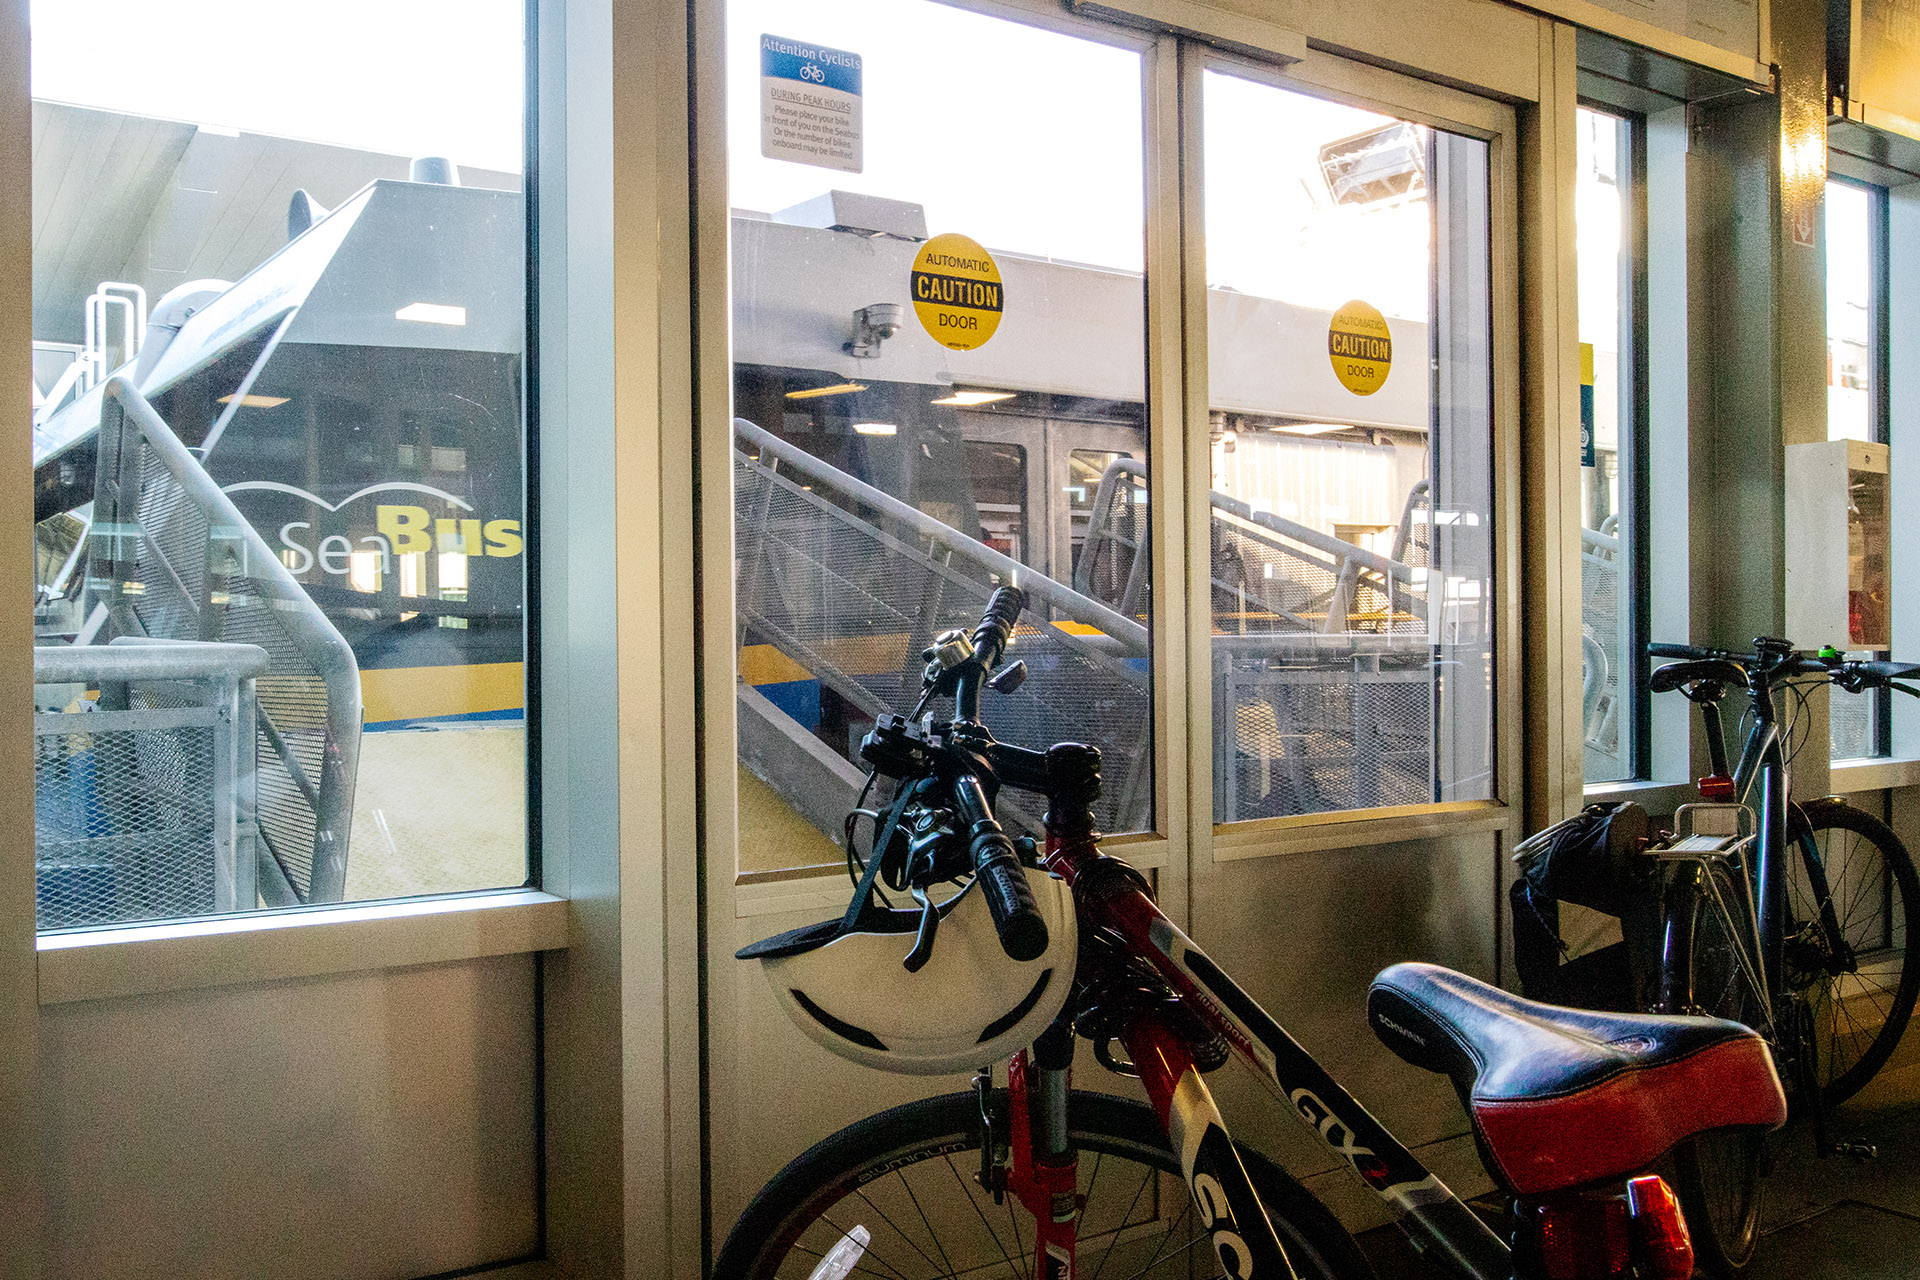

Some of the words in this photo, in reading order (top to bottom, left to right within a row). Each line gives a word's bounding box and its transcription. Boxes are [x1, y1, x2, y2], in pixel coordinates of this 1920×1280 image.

[762, 38, 816, 61] Attention
[818, 50, 862, 69] Cyclists
[770, 87, 802, 103] DURING
[803, 93, 824, 106] PEAK
[824, 98, 852, 112] HOURS
[771, 115, 789, 127] front
[789, 119, 798, 129] of
[798, 122, 811, 134] you
[812, 123, 821, 132] on
[822, 124, 834, 134] the
[834, 126, 860, 139] Seabus
[774, 104, 798, 117] Please
[798, 108, 818, 122] place
[818, 114, 834, 125] your
[835, 114, 850, 127] bike
[772, 138, 803, 151] onboard
[803, 144, 818, 155] may
[818, 145, 828, 155] be
[828, 147, 853, 160] limited
[773, 126, 783, 137] Or
[783, 129, 796, 139] the
[796, 132, 824, 144] number
[824, 134, 832, 145] of
[832, 136, 852, 149] bikes
[926, 253, 990, 273] AUTOMATIC
[917, 275, 998, 308] CAUTION
[939, 313, 978, 330] DOOR
[1338, 315, 1383, 330] AUTOMATIC
[1332, 333, 1389, 360] CAUTION
[1347, 364, 1375, 379] DOOR
[1220, 1016, 1252, 1046] sport
[858, 1142, 968, 1183] aluminum
